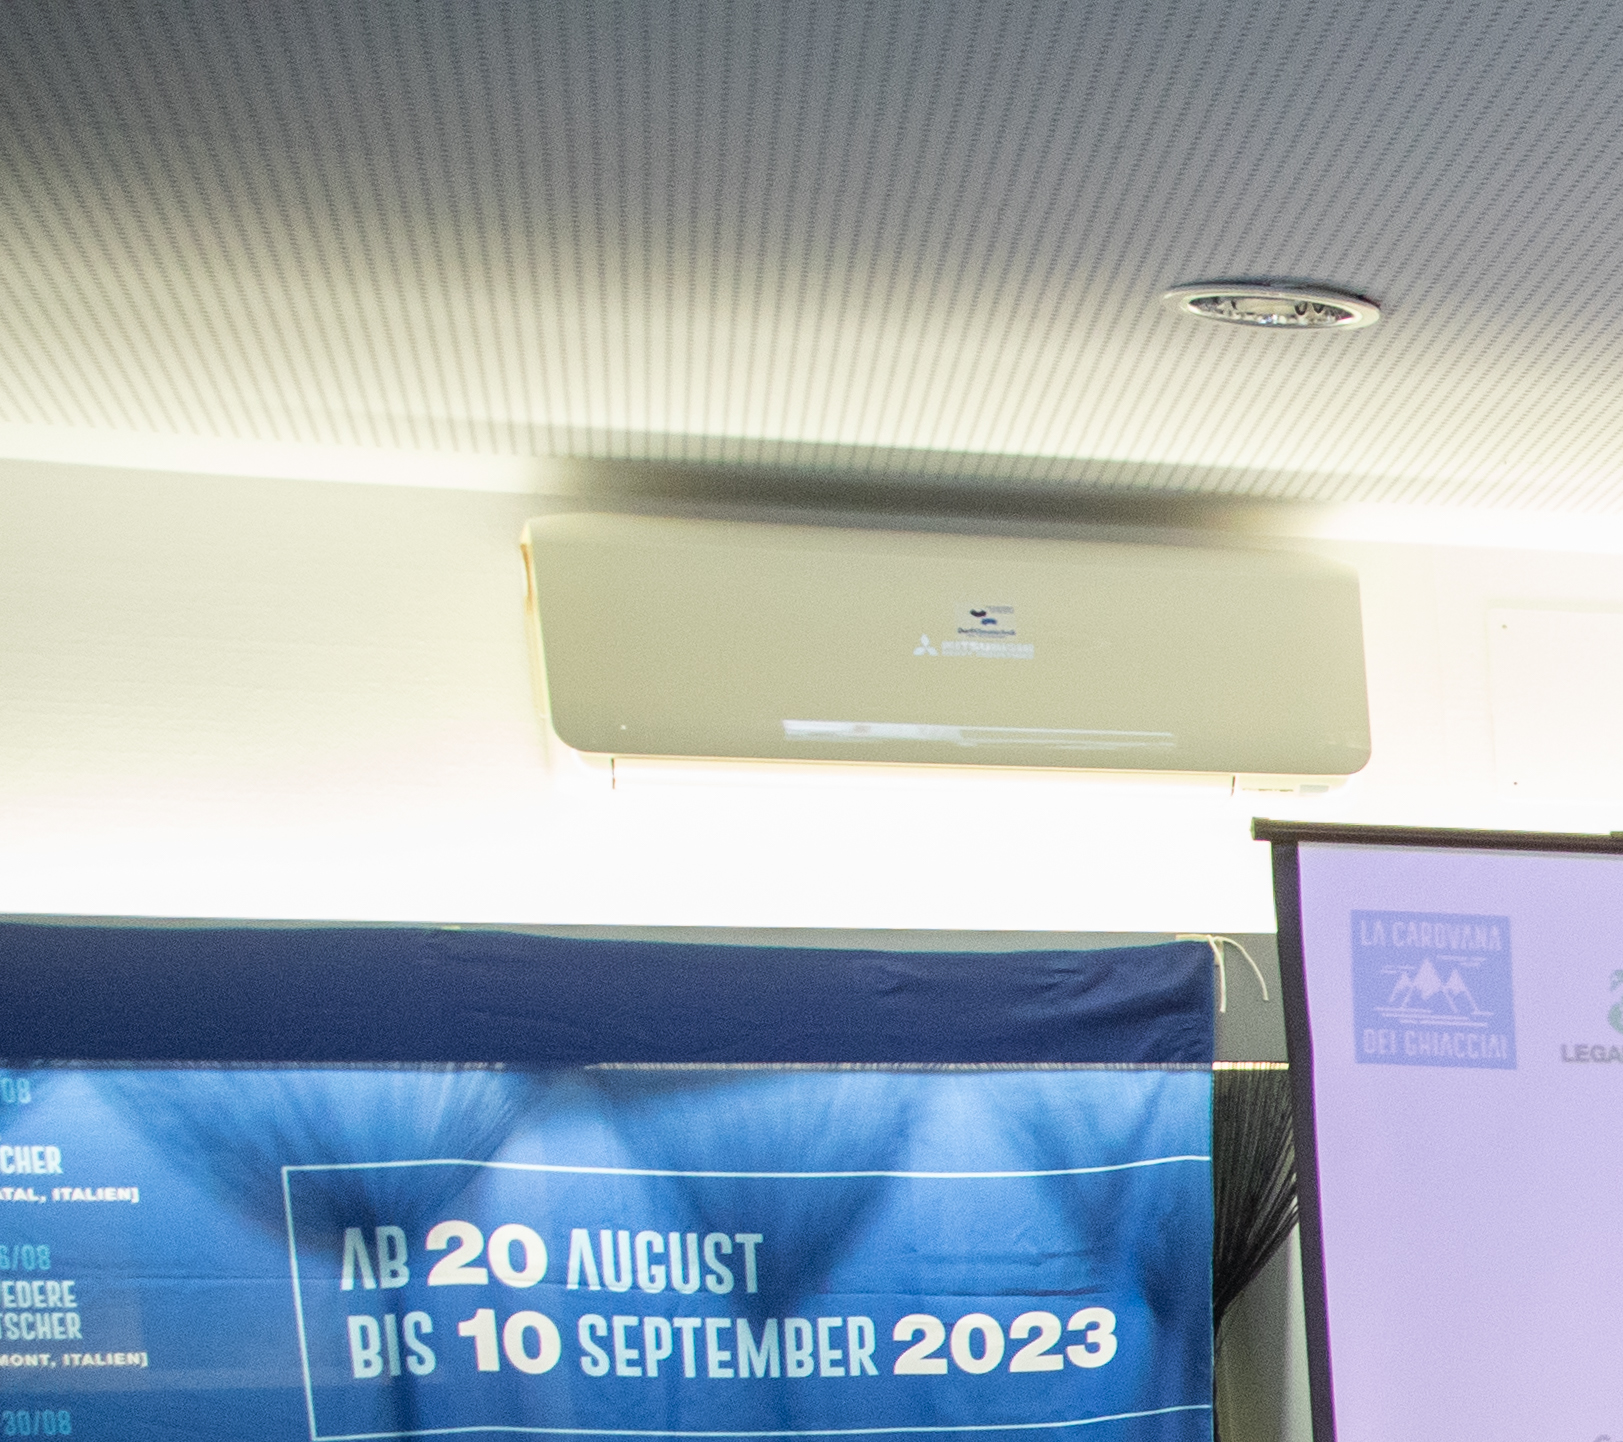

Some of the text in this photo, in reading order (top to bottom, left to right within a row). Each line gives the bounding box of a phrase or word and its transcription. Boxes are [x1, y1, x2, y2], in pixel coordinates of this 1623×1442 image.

[52, 1186, 140, 1203] ITALIEN]
[340, 1220, 764, 1296] AB 20 AUGUST
[62, 1352, 149, 1368] ITALIEN]
[348, 1306, 1119, 1380] BIS 10 SEPTEMBER 2023
